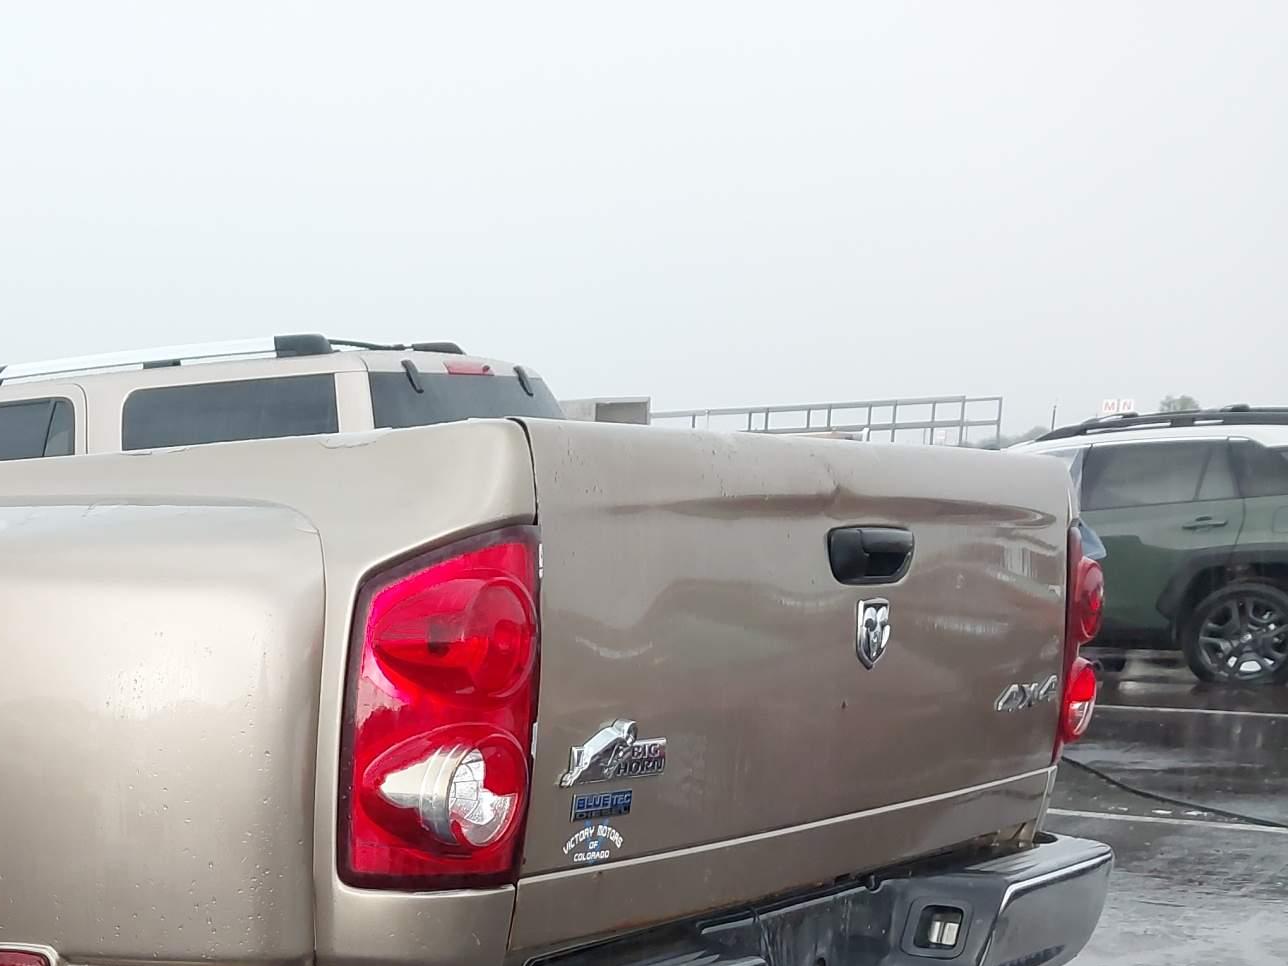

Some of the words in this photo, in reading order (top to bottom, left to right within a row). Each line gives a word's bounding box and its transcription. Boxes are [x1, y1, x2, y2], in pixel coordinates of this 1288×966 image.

[631, 744, 661, 759] BIG
[616, 759, 665, 776] HORN
[562, 825, 596, 855] VICTORY
[597, 824, 624, 849] MOTORS
[588, 840, 600, 850] OF
[573, 849, 610, 862] COLORADO
